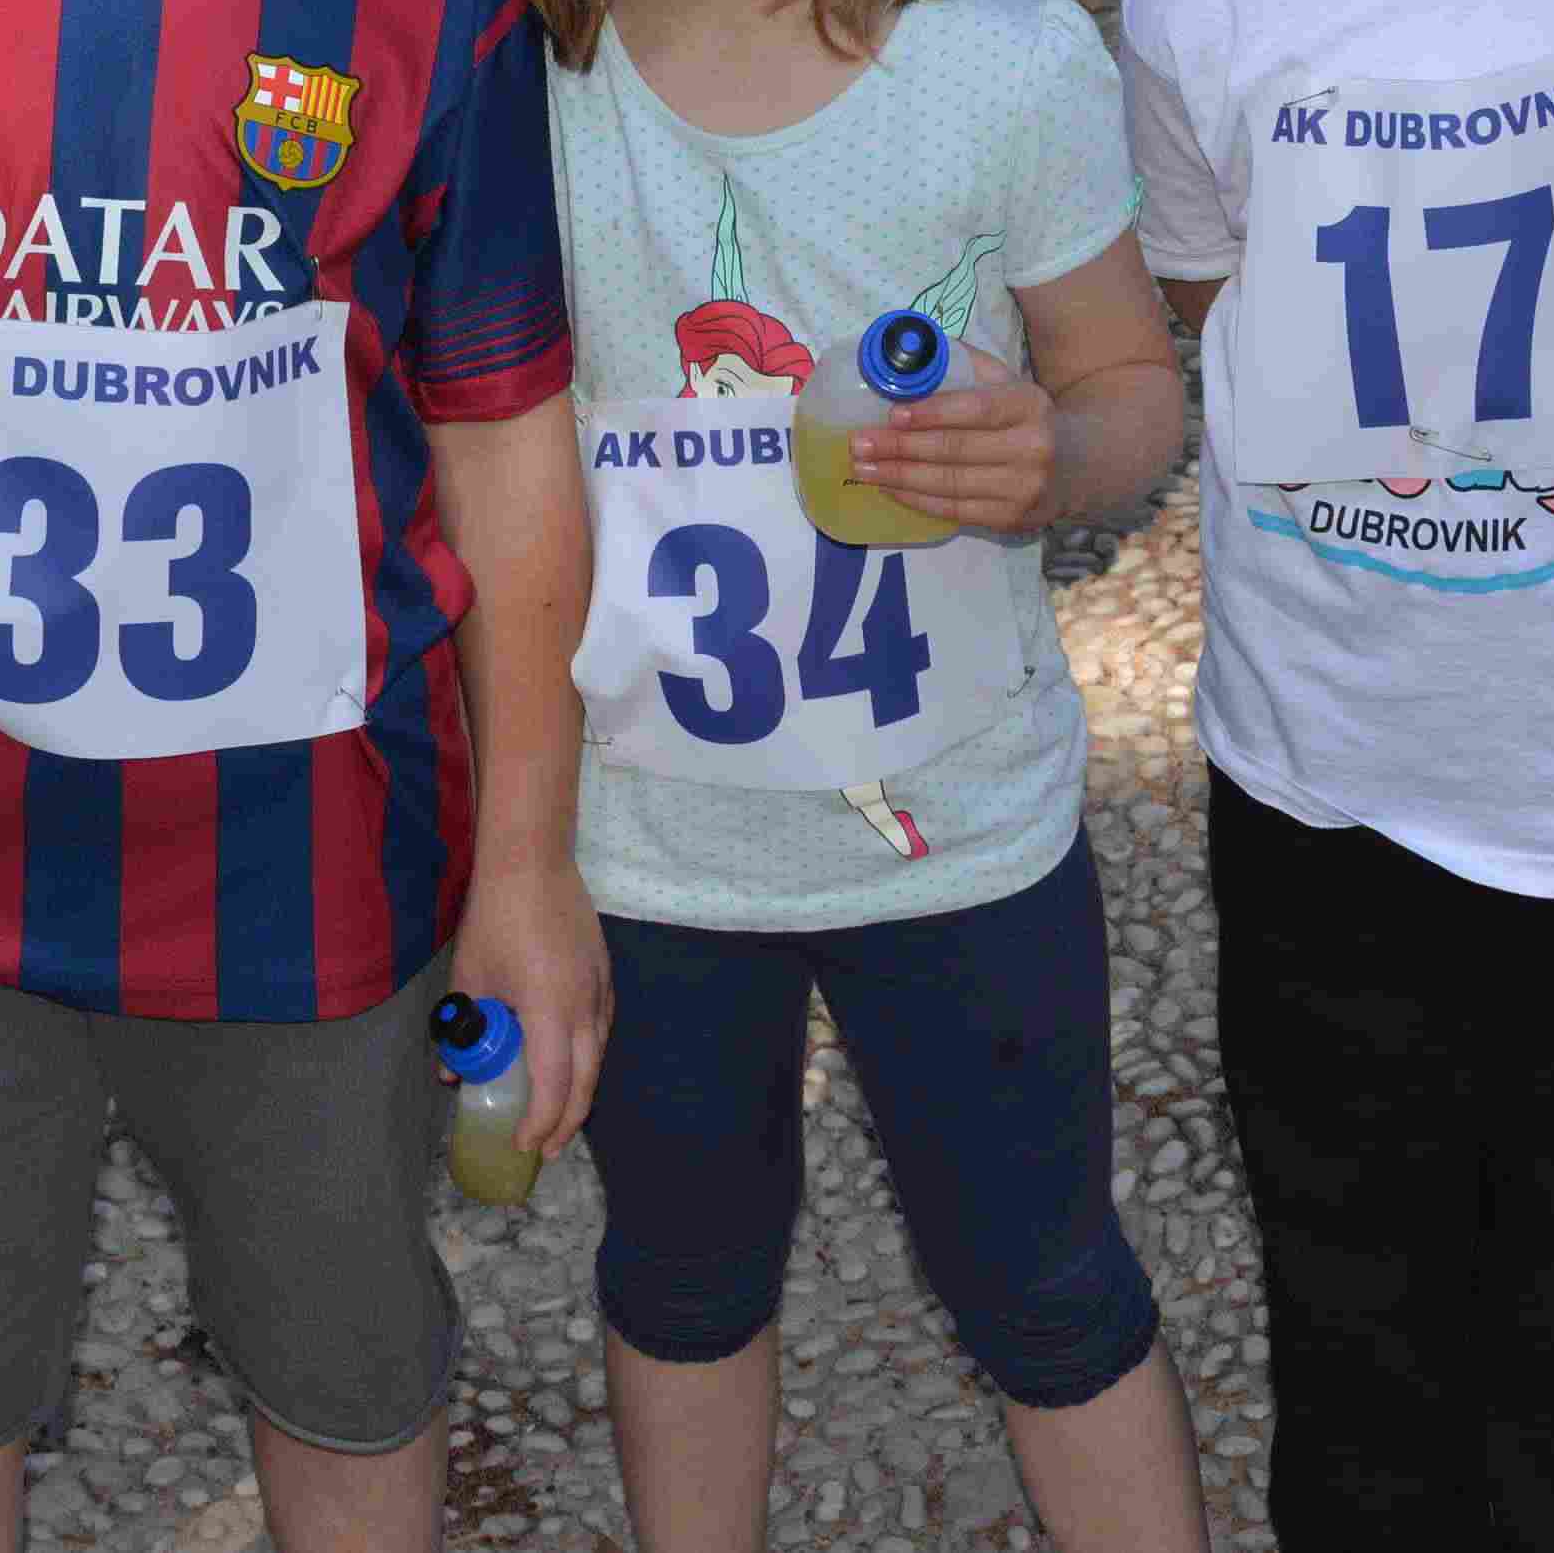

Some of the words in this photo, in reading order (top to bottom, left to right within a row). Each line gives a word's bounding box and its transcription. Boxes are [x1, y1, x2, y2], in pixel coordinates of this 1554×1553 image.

[1272, 107, 1329, 145] AK
[12, 336, 321, 406] DUBROVNIK
[594, 430, 662, 469] AK
[673, 427, 792, 468] DUB
[1308, 499, 1527, 553] DUBROVNIK
[647, 524, 932, 745] 34
